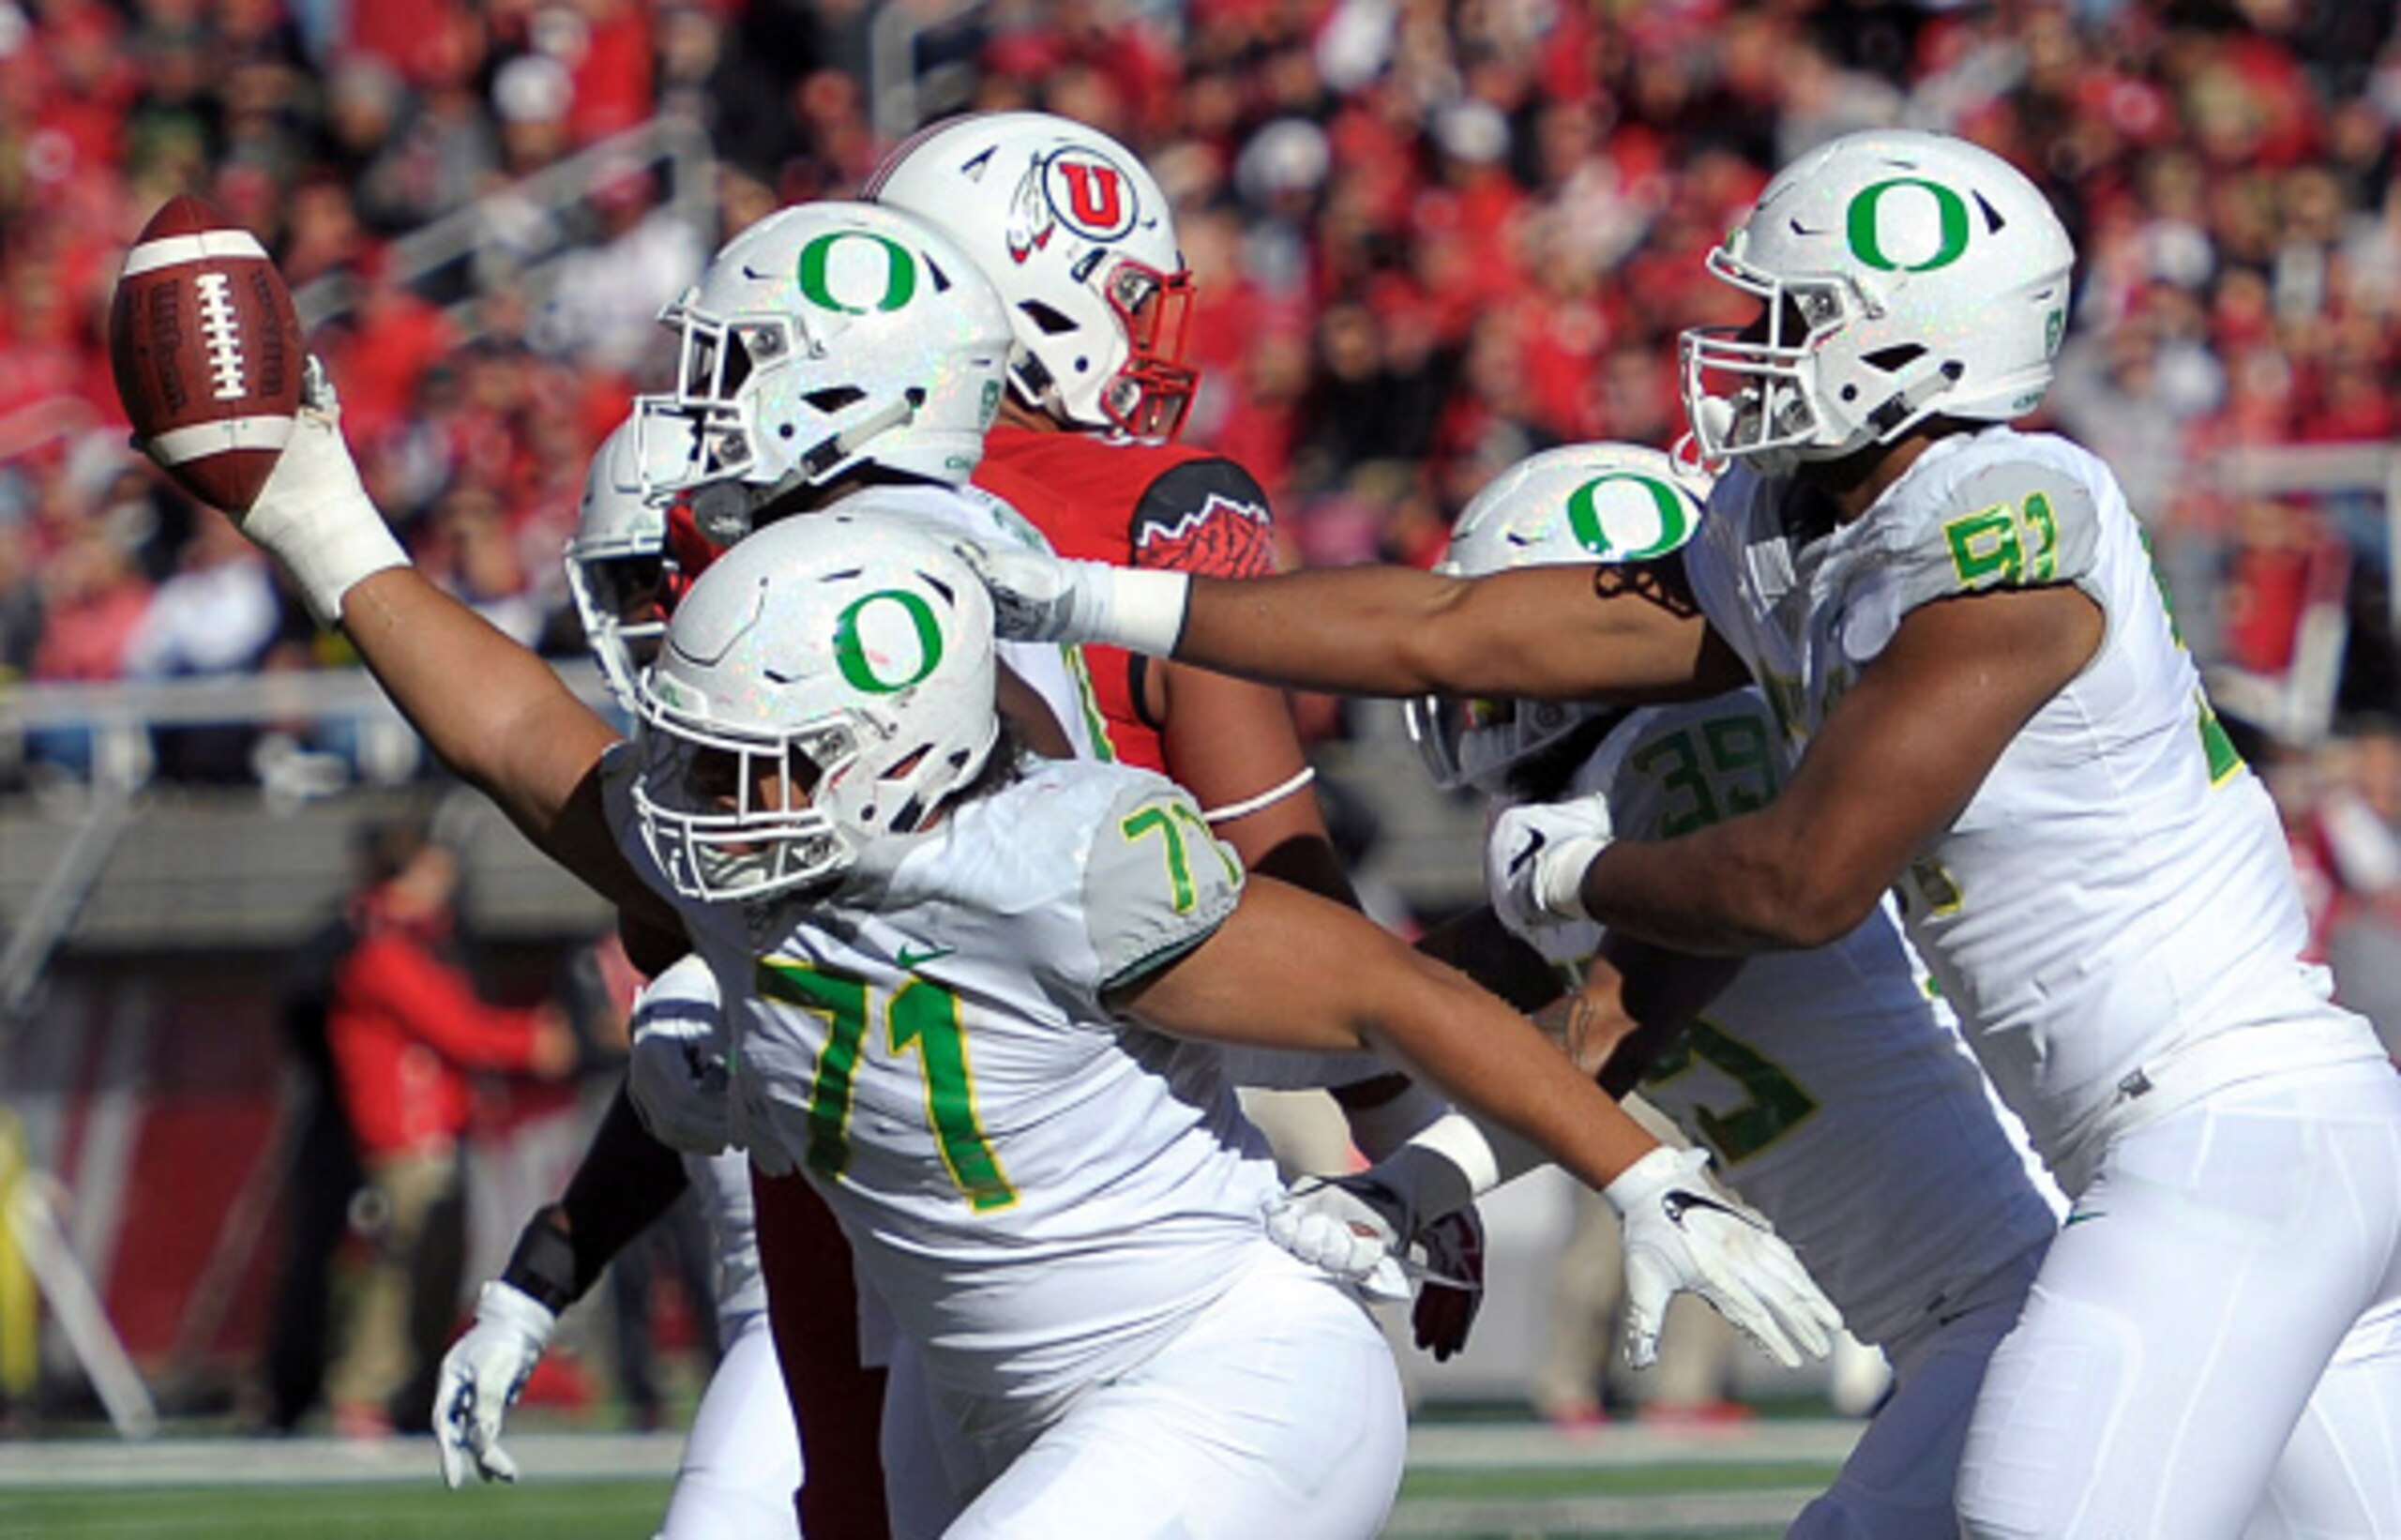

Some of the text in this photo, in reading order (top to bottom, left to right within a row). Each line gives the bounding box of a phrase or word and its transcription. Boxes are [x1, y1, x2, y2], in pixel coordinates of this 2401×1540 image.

[1057, 161, 1122, 230] U
[1847, 175, 1970, 274] O
[796, 229, 919, 314] O
[1565, 471, 1687, 561] O
[833, 588, 944, 696] O
[1629, 711, 1780, 840] 39
[756, 954, 1023, 1216] 71
